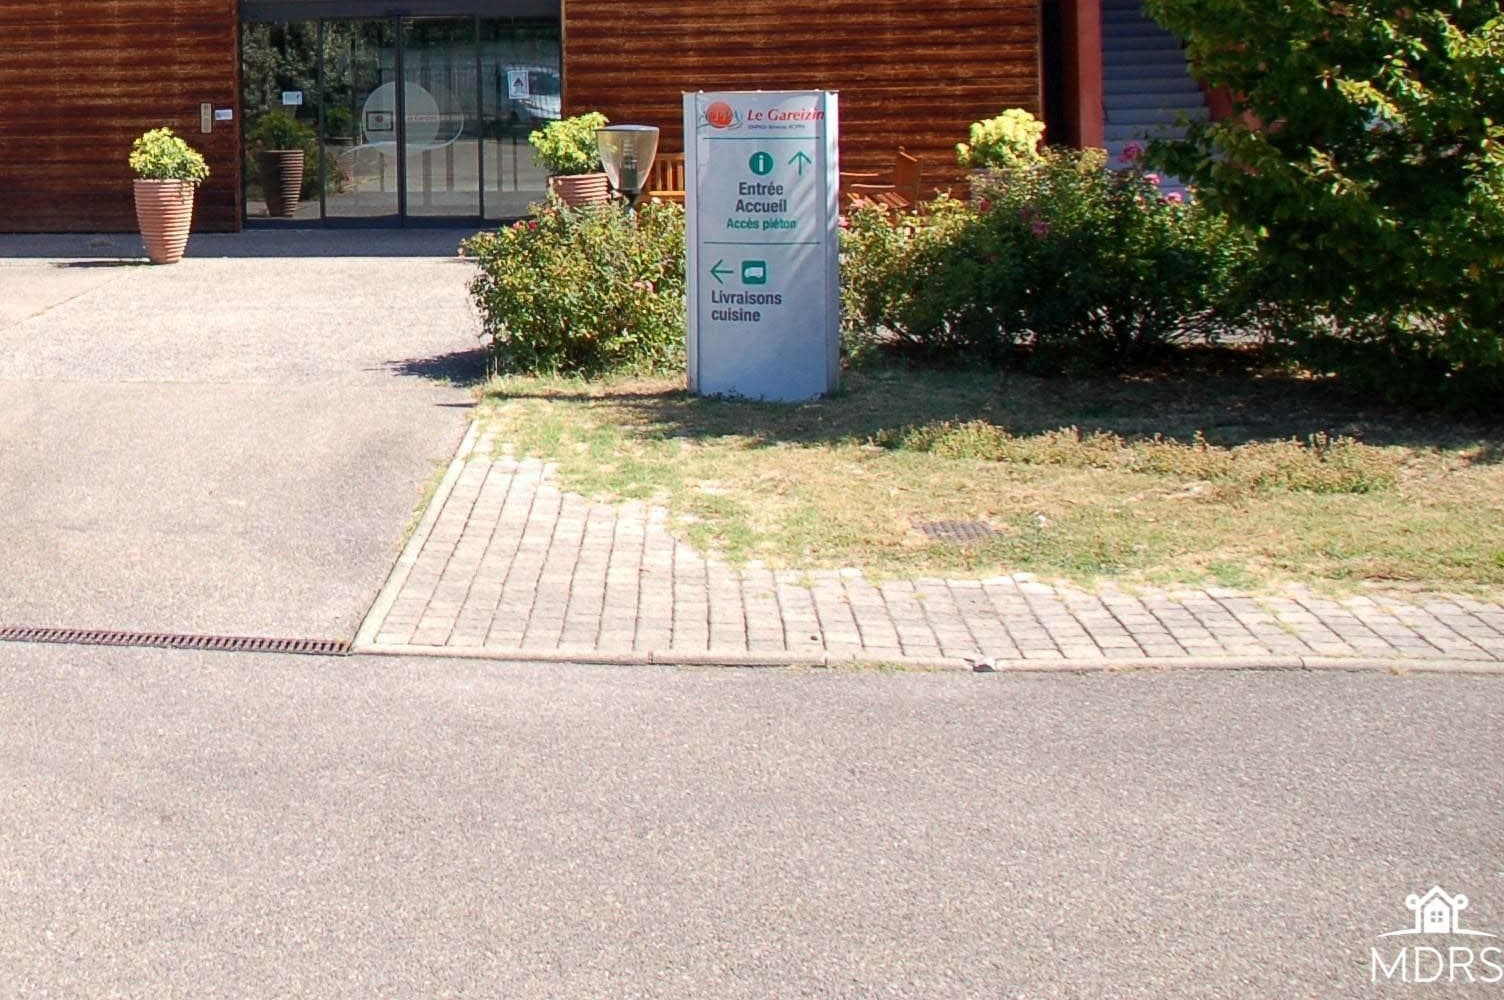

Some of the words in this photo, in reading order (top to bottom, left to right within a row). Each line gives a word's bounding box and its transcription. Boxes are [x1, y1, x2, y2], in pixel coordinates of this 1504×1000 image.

[747, 109, 763, 121] Le
[767, 107, 825, 121] Gareizin
[739, 181, 784, 196] Entrée
[736, 199, 787, 213] Accueil
[727, 217, 759, 229] Accès
[762, 217, 797, 231] piéton
[711, 290, 782, 305] Livraisons
[711, 307, 761, 322] cuisine
